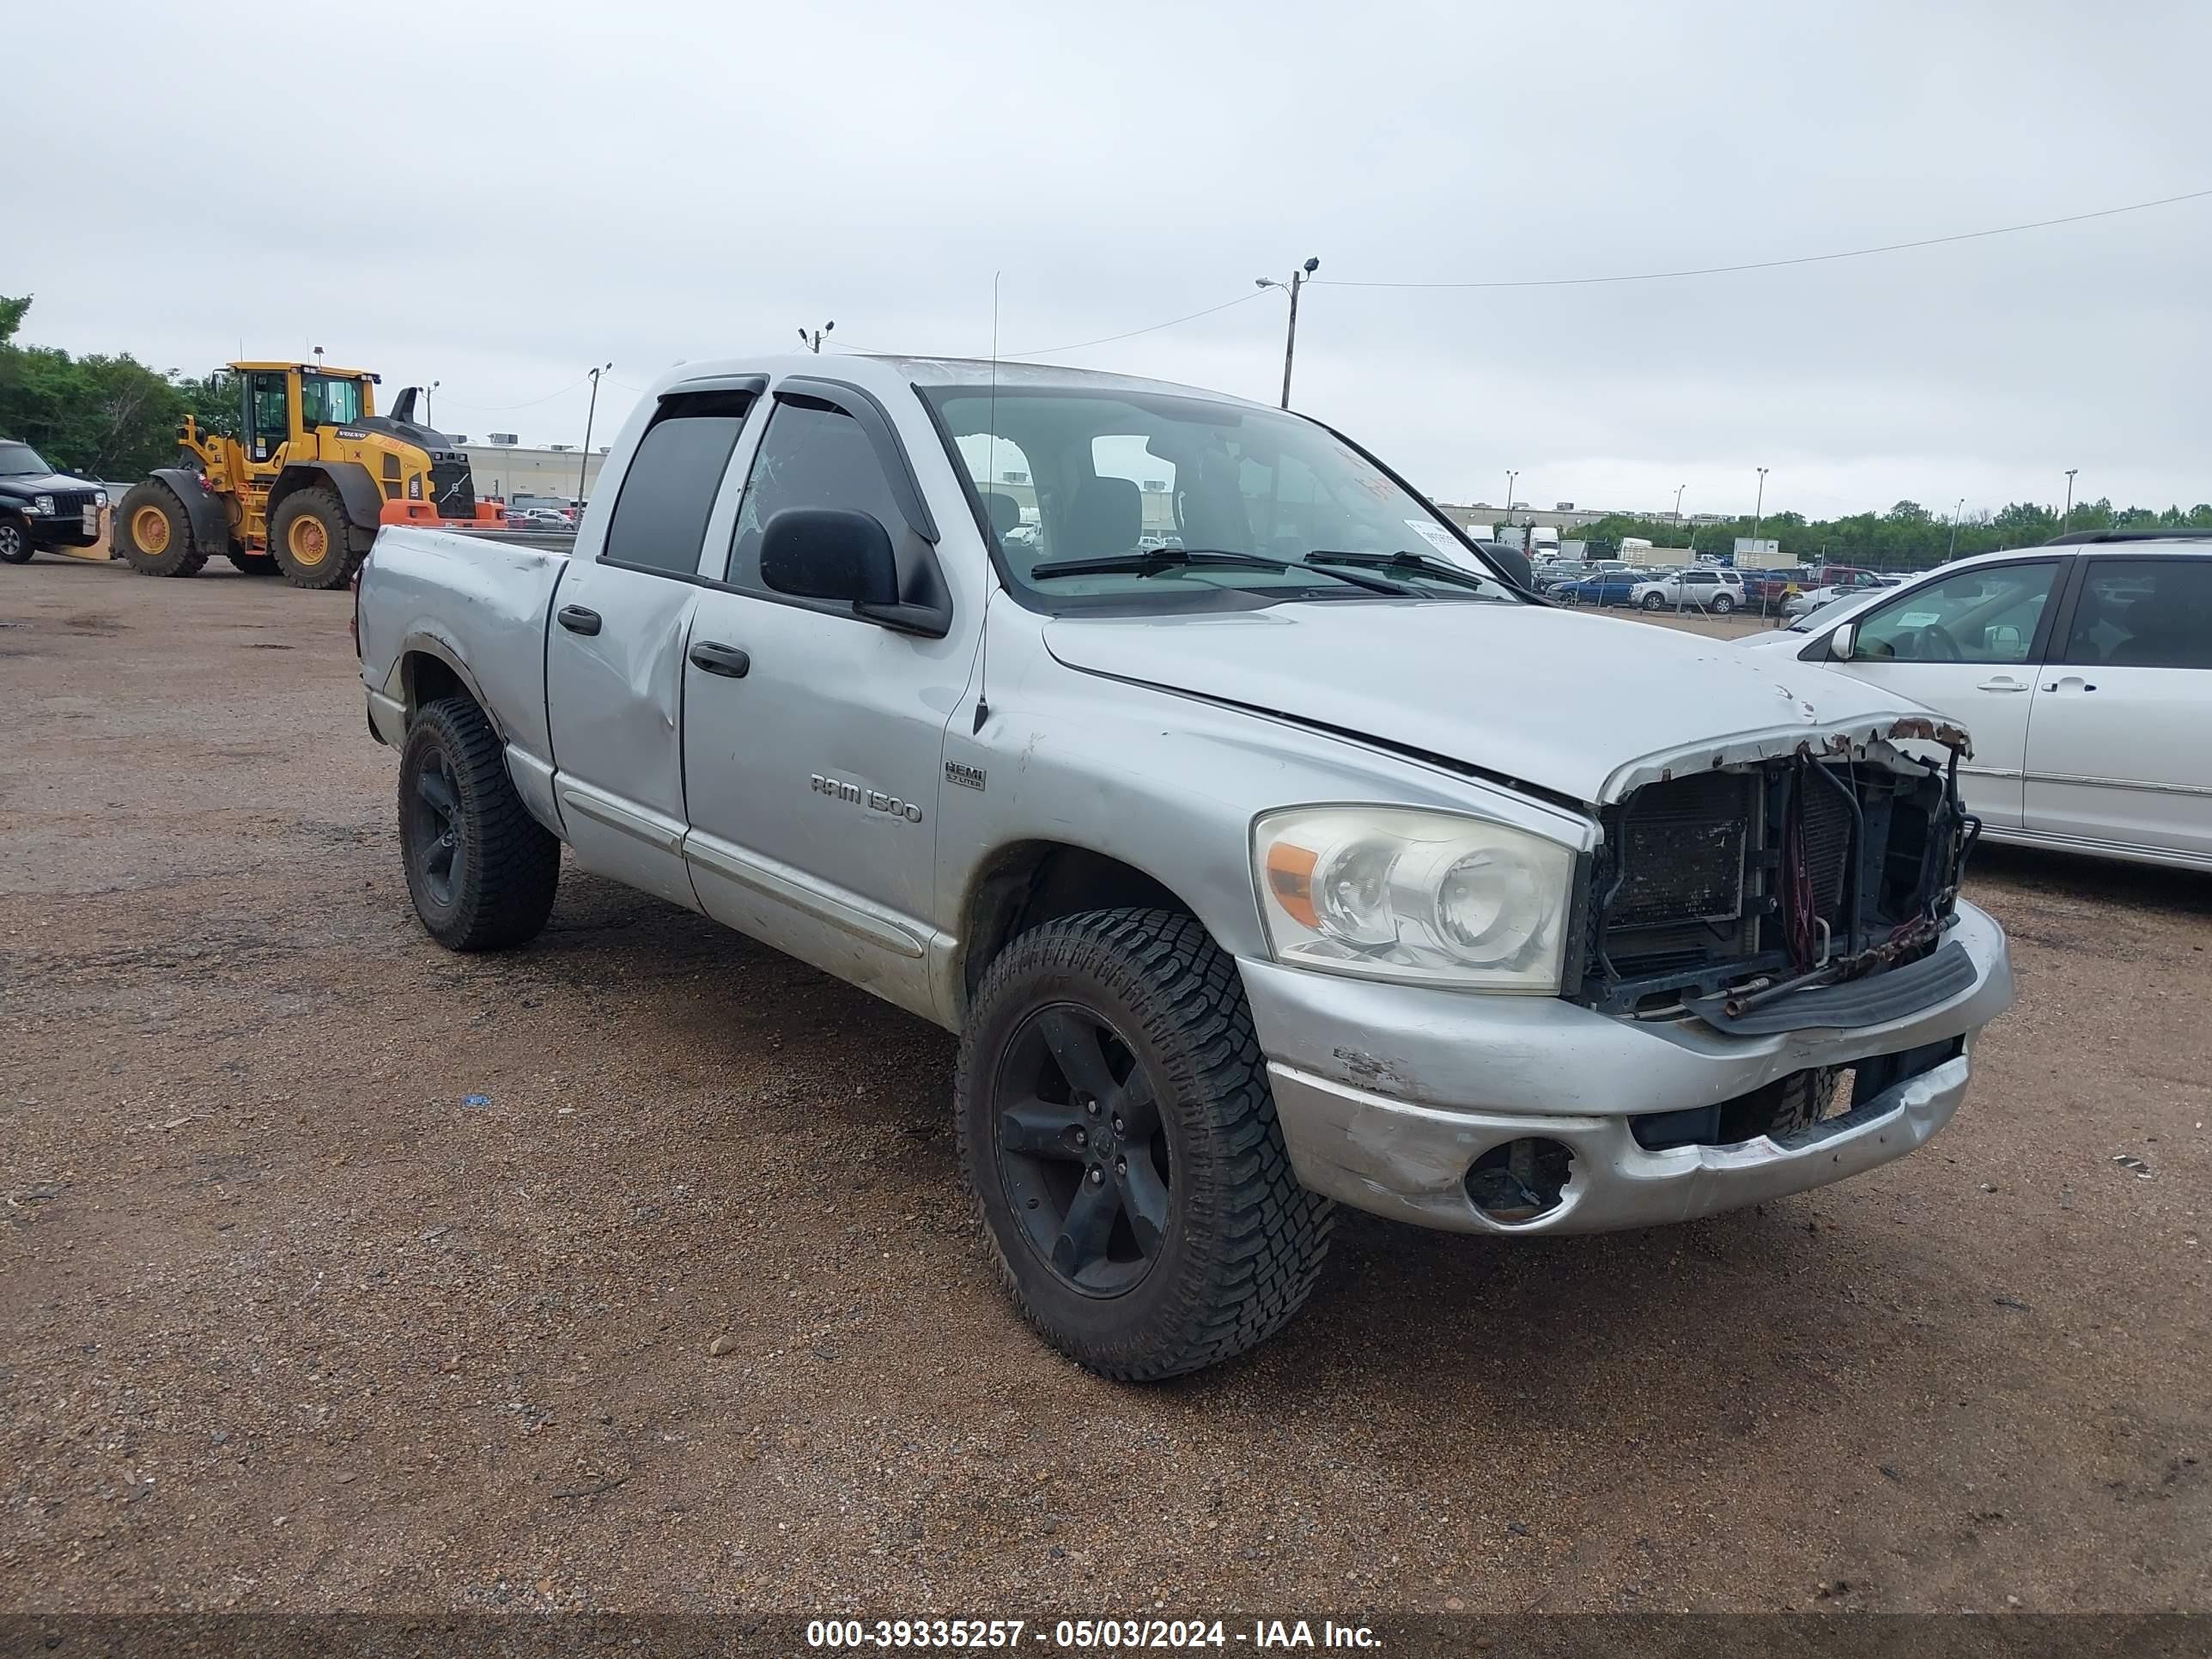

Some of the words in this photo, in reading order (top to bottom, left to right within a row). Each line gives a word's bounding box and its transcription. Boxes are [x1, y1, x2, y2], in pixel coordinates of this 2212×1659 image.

[338, 430, 366, 439] VOLVO
[410, 481, 419, 497] L90H
[945, 761, 982, 781] HEMI
[959, 776, 981, 788] LITER
[811, 772, 861, 805] RAM
[866, 788, 923, 823] 1500
